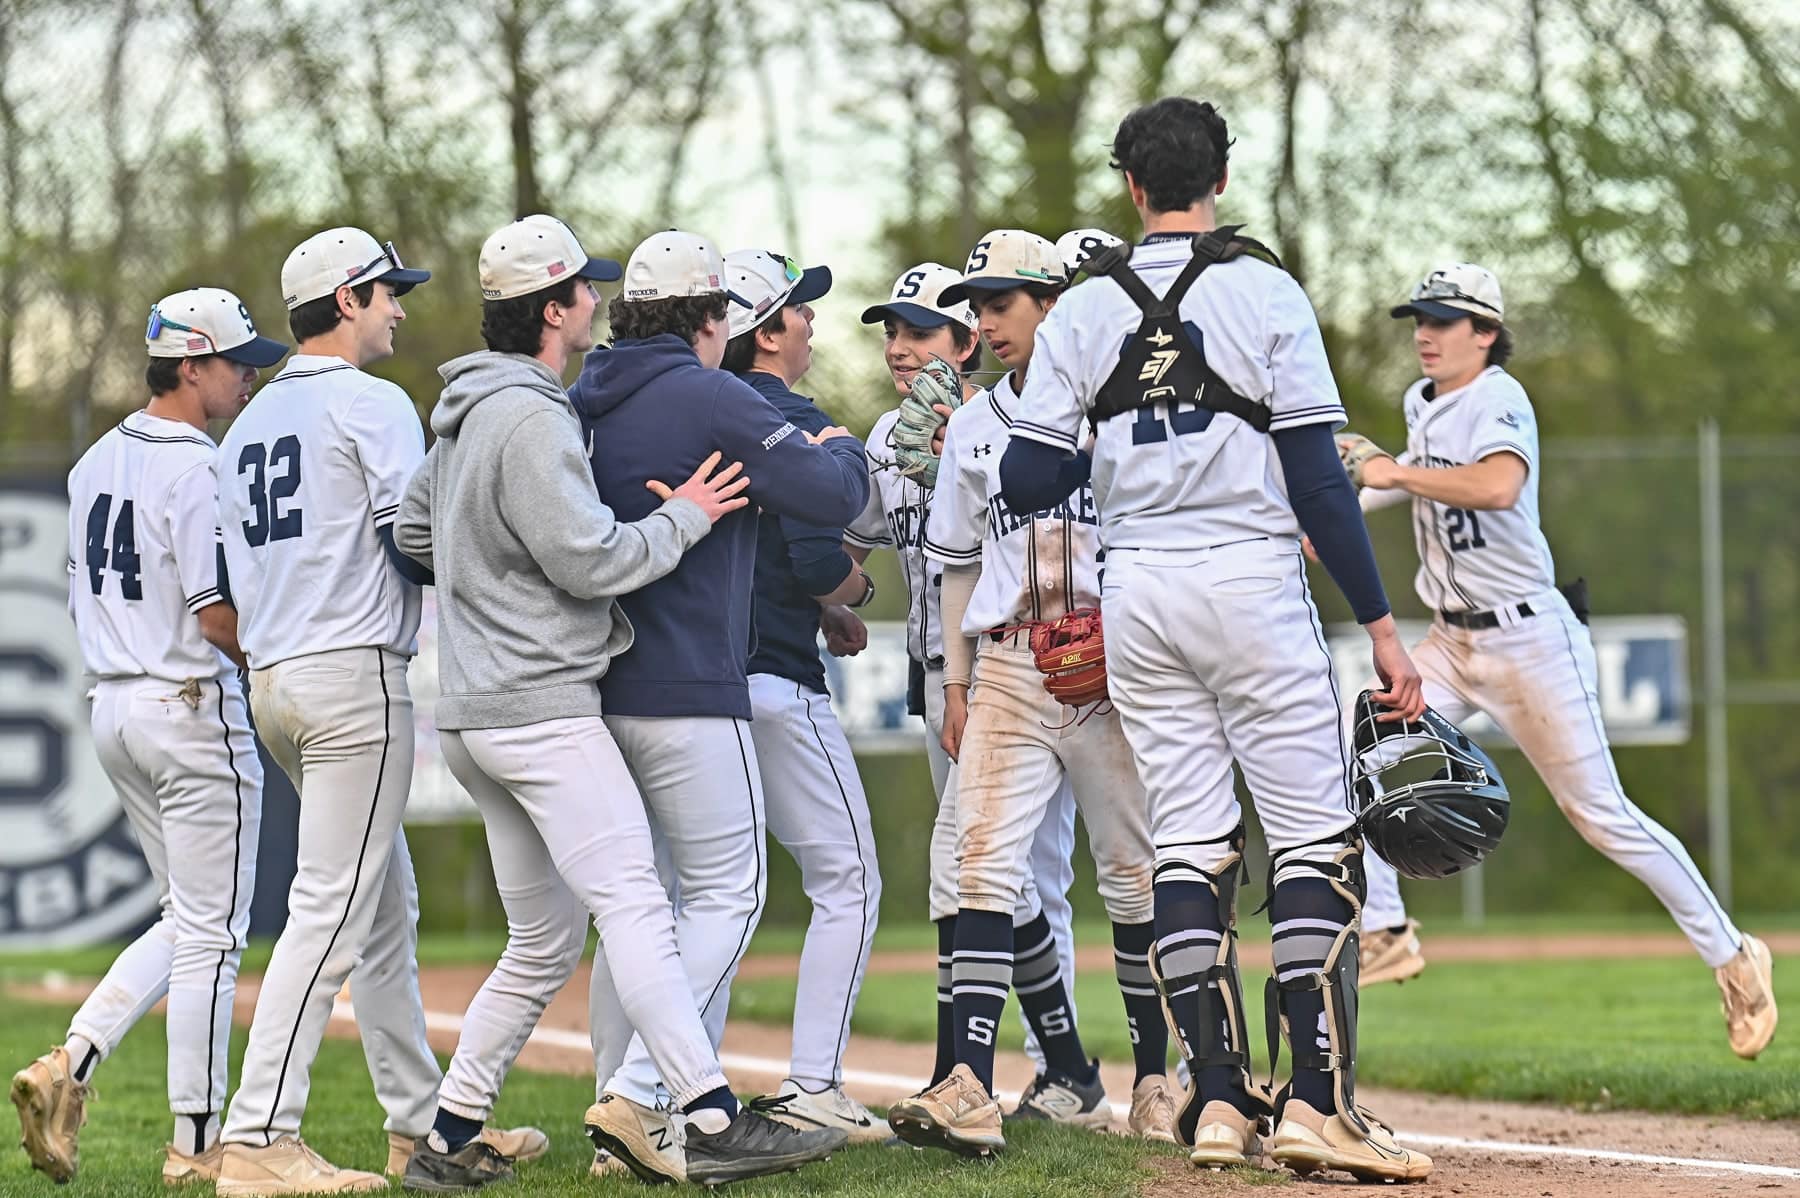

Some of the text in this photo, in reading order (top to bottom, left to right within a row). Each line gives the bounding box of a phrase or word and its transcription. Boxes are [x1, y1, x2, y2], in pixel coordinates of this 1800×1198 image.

[967, 242, 990, 274] S
[897, 272, 926, 298] S
[238, 434, 302, 547] 32
[86, 493, 143, 600] 44
[1445, 508, 1487, 552] 21
[967, 1015, 996, 1047] S
[1039, 1005, 1071, 1038] S
